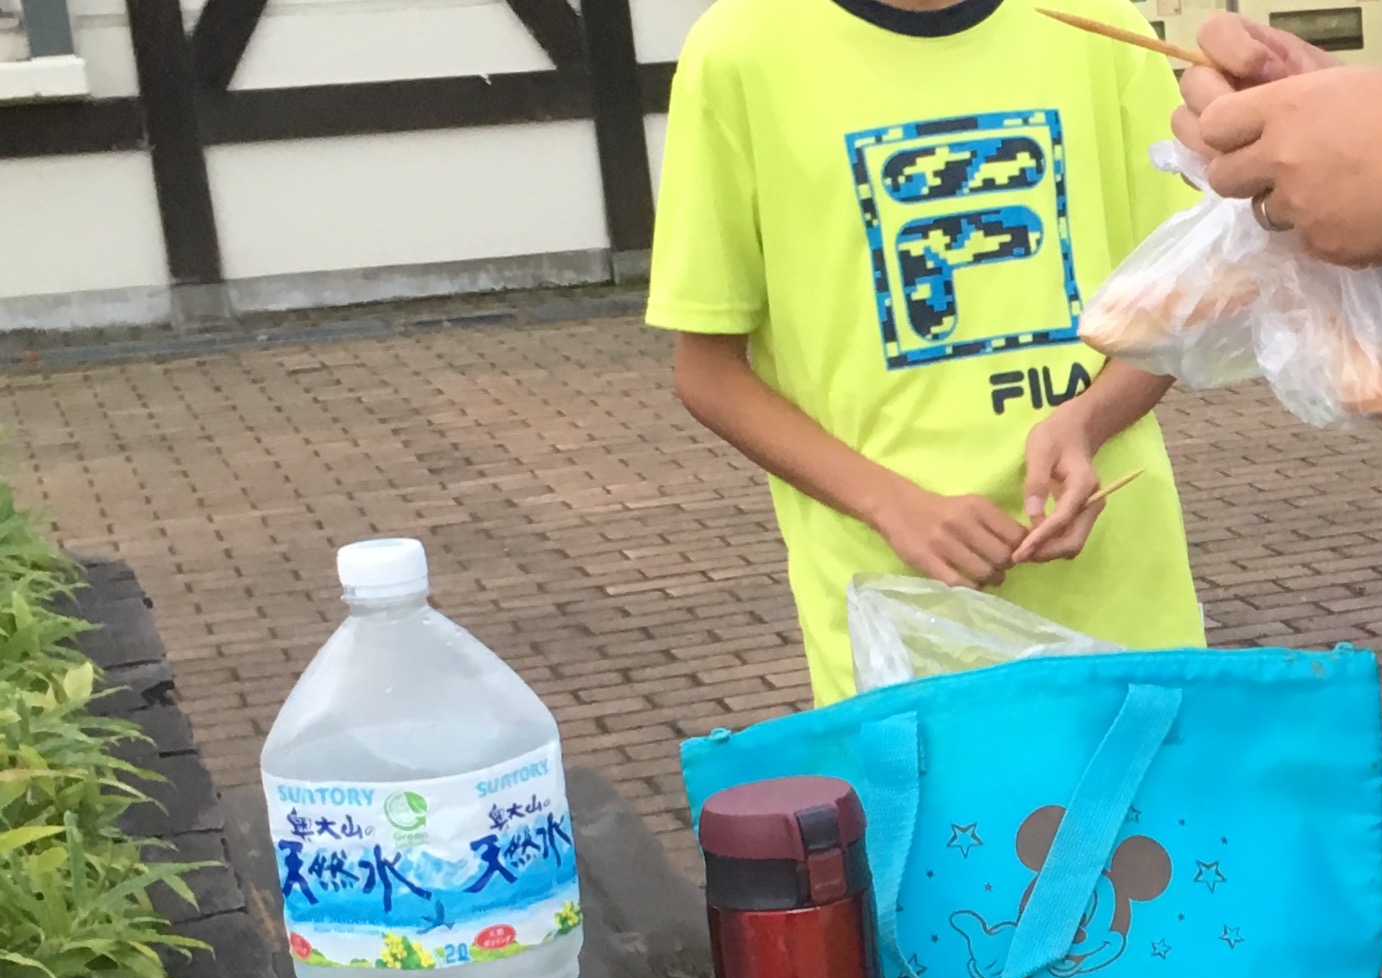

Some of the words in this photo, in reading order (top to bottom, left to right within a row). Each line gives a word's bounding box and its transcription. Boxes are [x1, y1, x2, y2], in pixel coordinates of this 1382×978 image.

[989, 362, 1093, 415] FILA
[277, 784, 376, 806] SUNTORY
[278, 838, 432, 914] 天然水
[462, 811, 572, 894] 天然水
